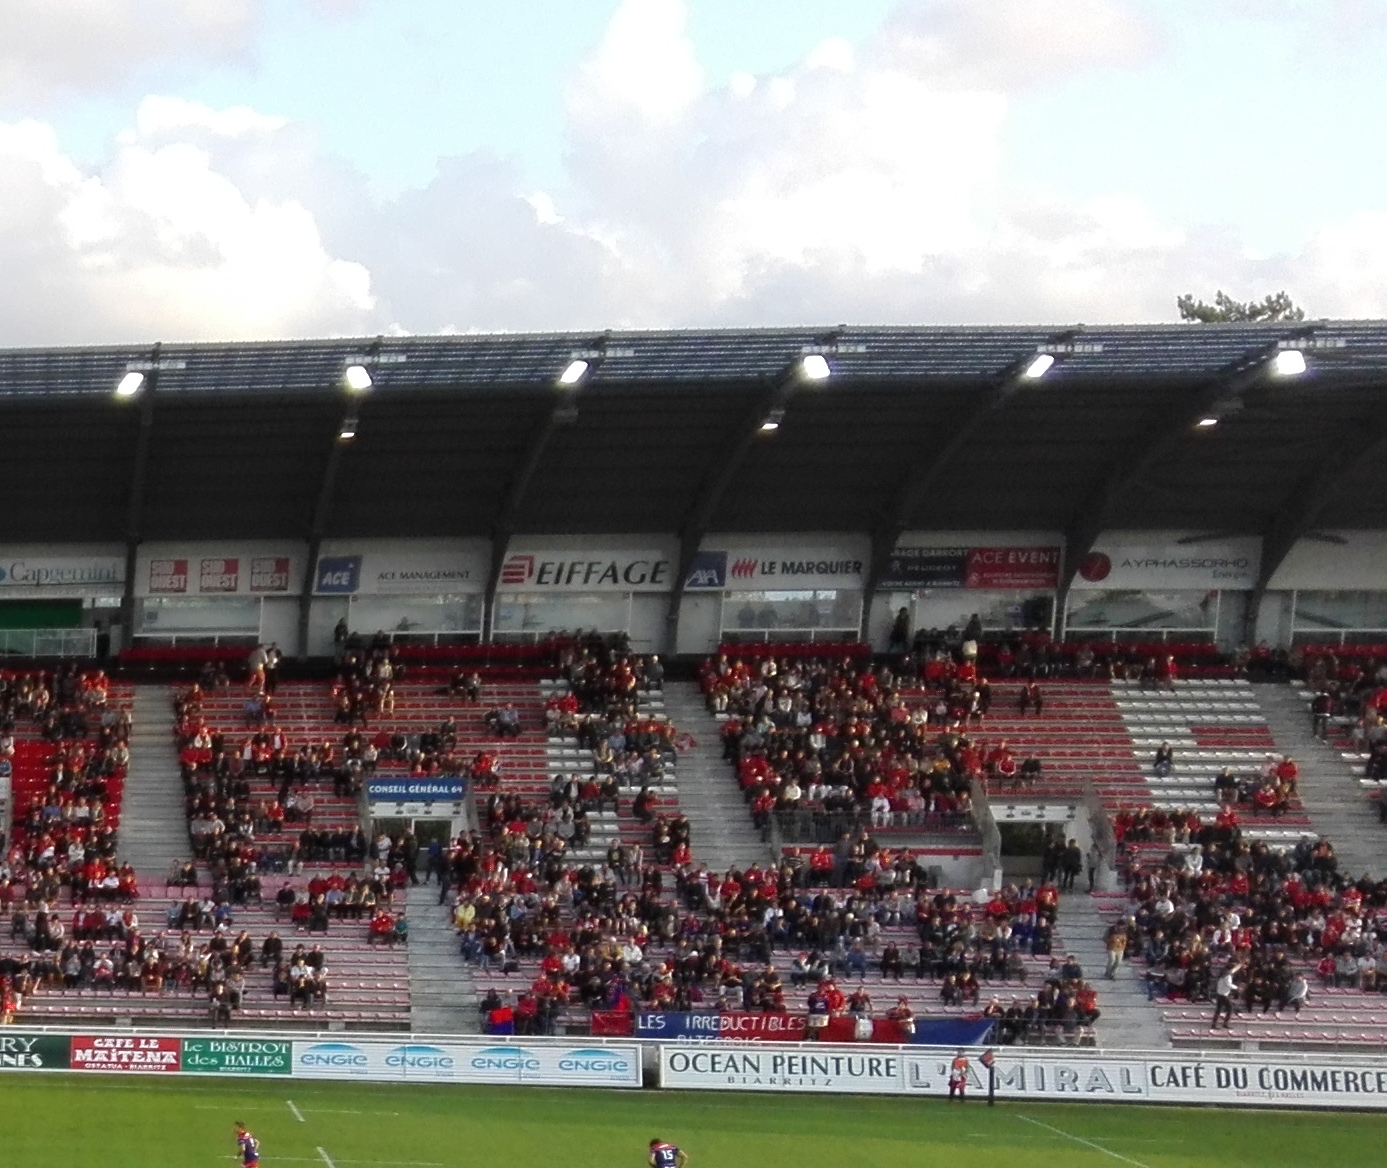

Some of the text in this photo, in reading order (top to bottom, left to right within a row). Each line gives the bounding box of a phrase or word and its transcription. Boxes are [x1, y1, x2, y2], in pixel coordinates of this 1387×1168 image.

[971, 552, 1058, 564] ACE EVENT
[10, 562, 116, 587] Capgemini
[536, 560, 669, 585] EIFFAGE
[760, 560, 862, 576] LE MARQUIER
[322, 572, 350, 585] ACE
[377, 570, 471, 580] ACE MANAGEMENT
[685, 569, 719, 587] AXA
[368, 784, 463, 794] CONSEIL GÉNÉRAL 64
[638, 1014, 806, 1032] LES IRREDUCTIBLES
[139, 1038, 159, 1048] LE
[184, 1041, 290, 1054] Le BISTROT
[187, 1054, 285, 1068] des HALLES
[669, 1053, 897, 1078] OCEAN PEINTURE
[727, 1076, 833, 1087] BIARRITZ
[1150, 1063, 1387, 1095] CAFÉ DU COMMERCE
[662, 1150, 674, 1160] 15
